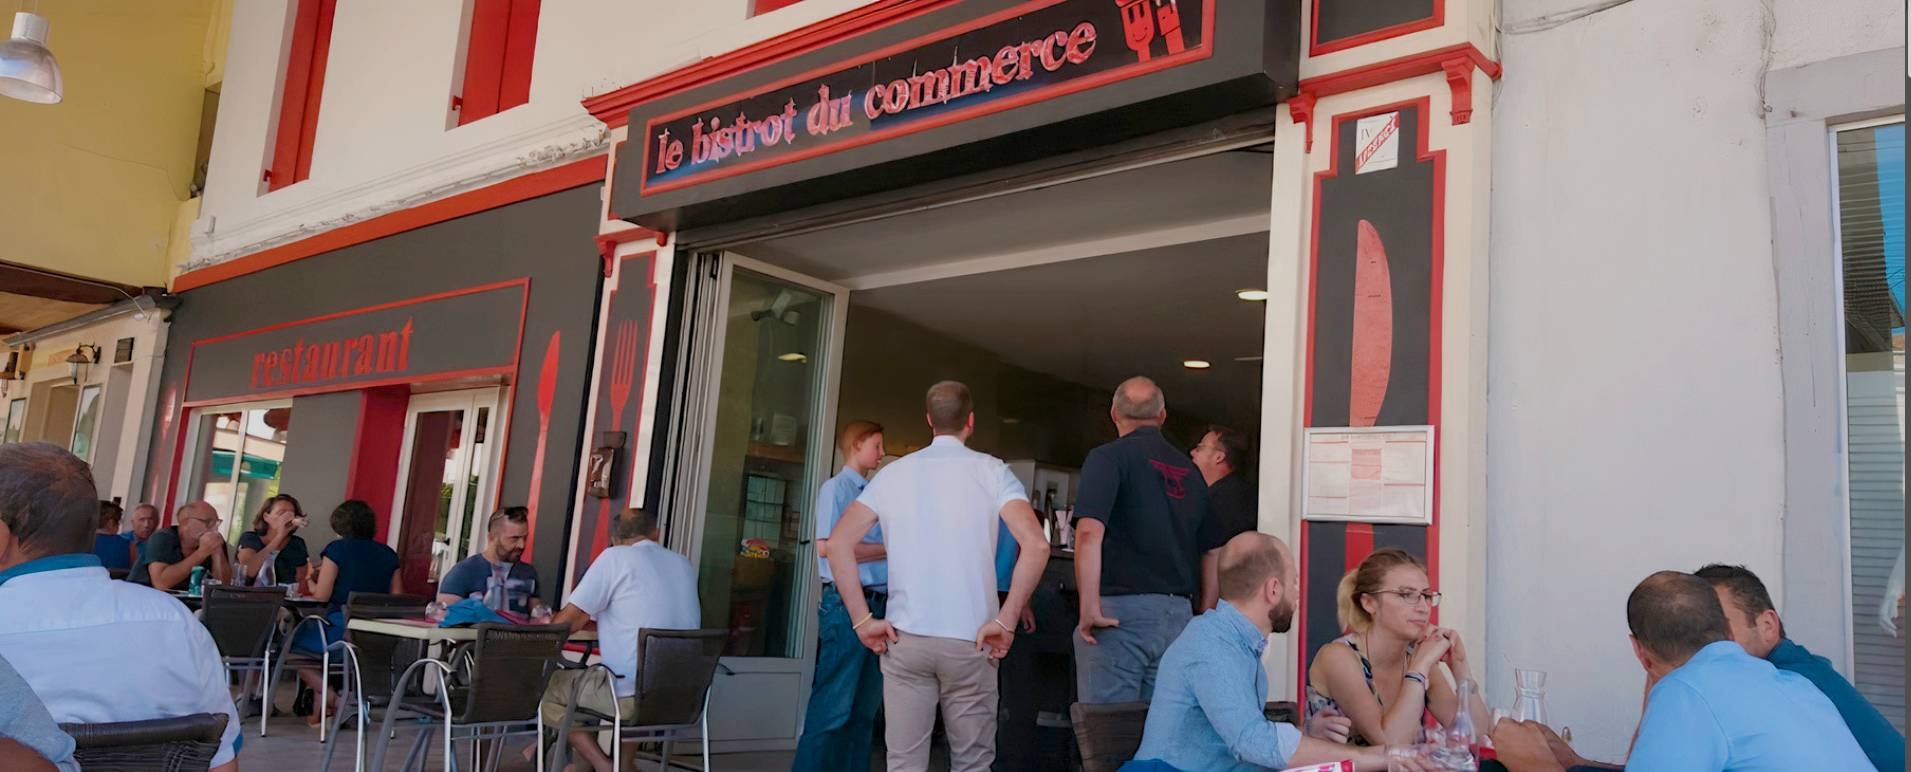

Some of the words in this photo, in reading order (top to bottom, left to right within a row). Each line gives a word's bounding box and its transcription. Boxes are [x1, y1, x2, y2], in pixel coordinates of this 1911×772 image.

[655, 128, 684, 174] le
[691, 97, 798, 165] bistrot
[807, 83, 854, 137] du
[864, 21, 1098, 121] commerce
[251, 316, 414, 391] restaurant
